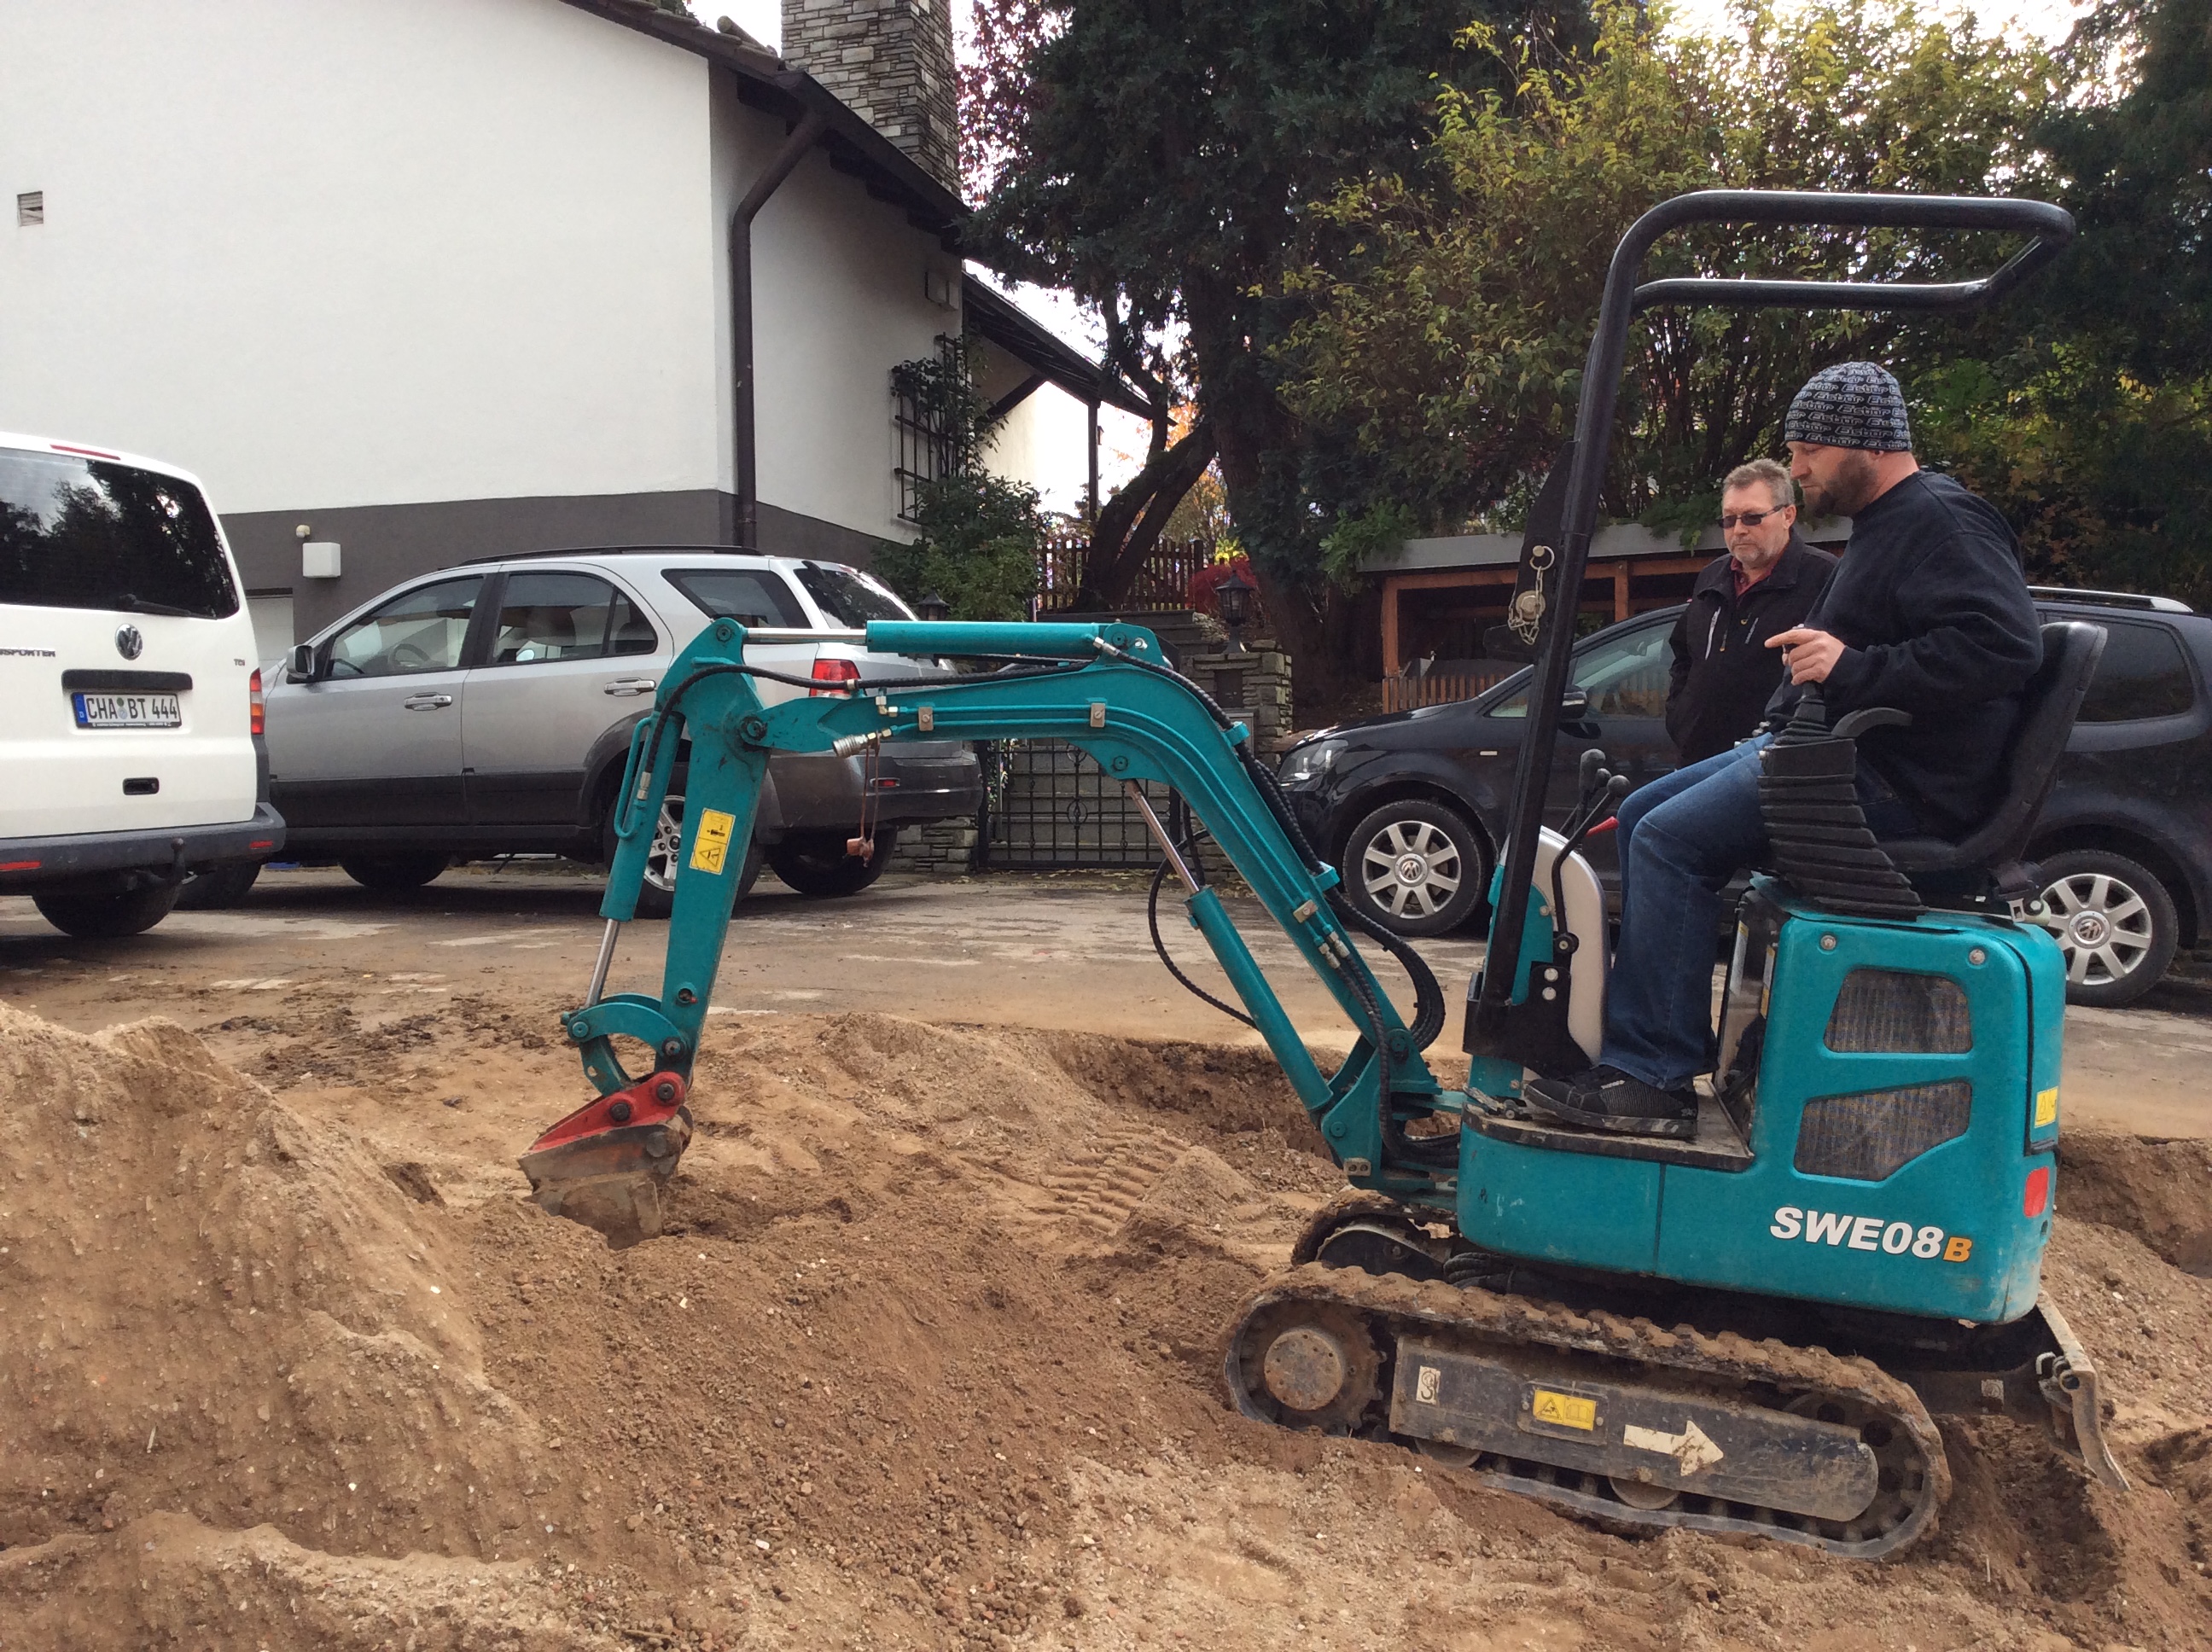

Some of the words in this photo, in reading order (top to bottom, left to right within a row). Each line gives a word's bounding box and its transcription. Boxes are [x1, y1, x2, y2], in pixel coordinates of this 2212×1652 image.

[86, 697, 118, 719] CHA
[126, 698, 147, 719] BT
[152, 698, 178, 719] 444
[1769, 1206, 1973, 1263] SWE08B
